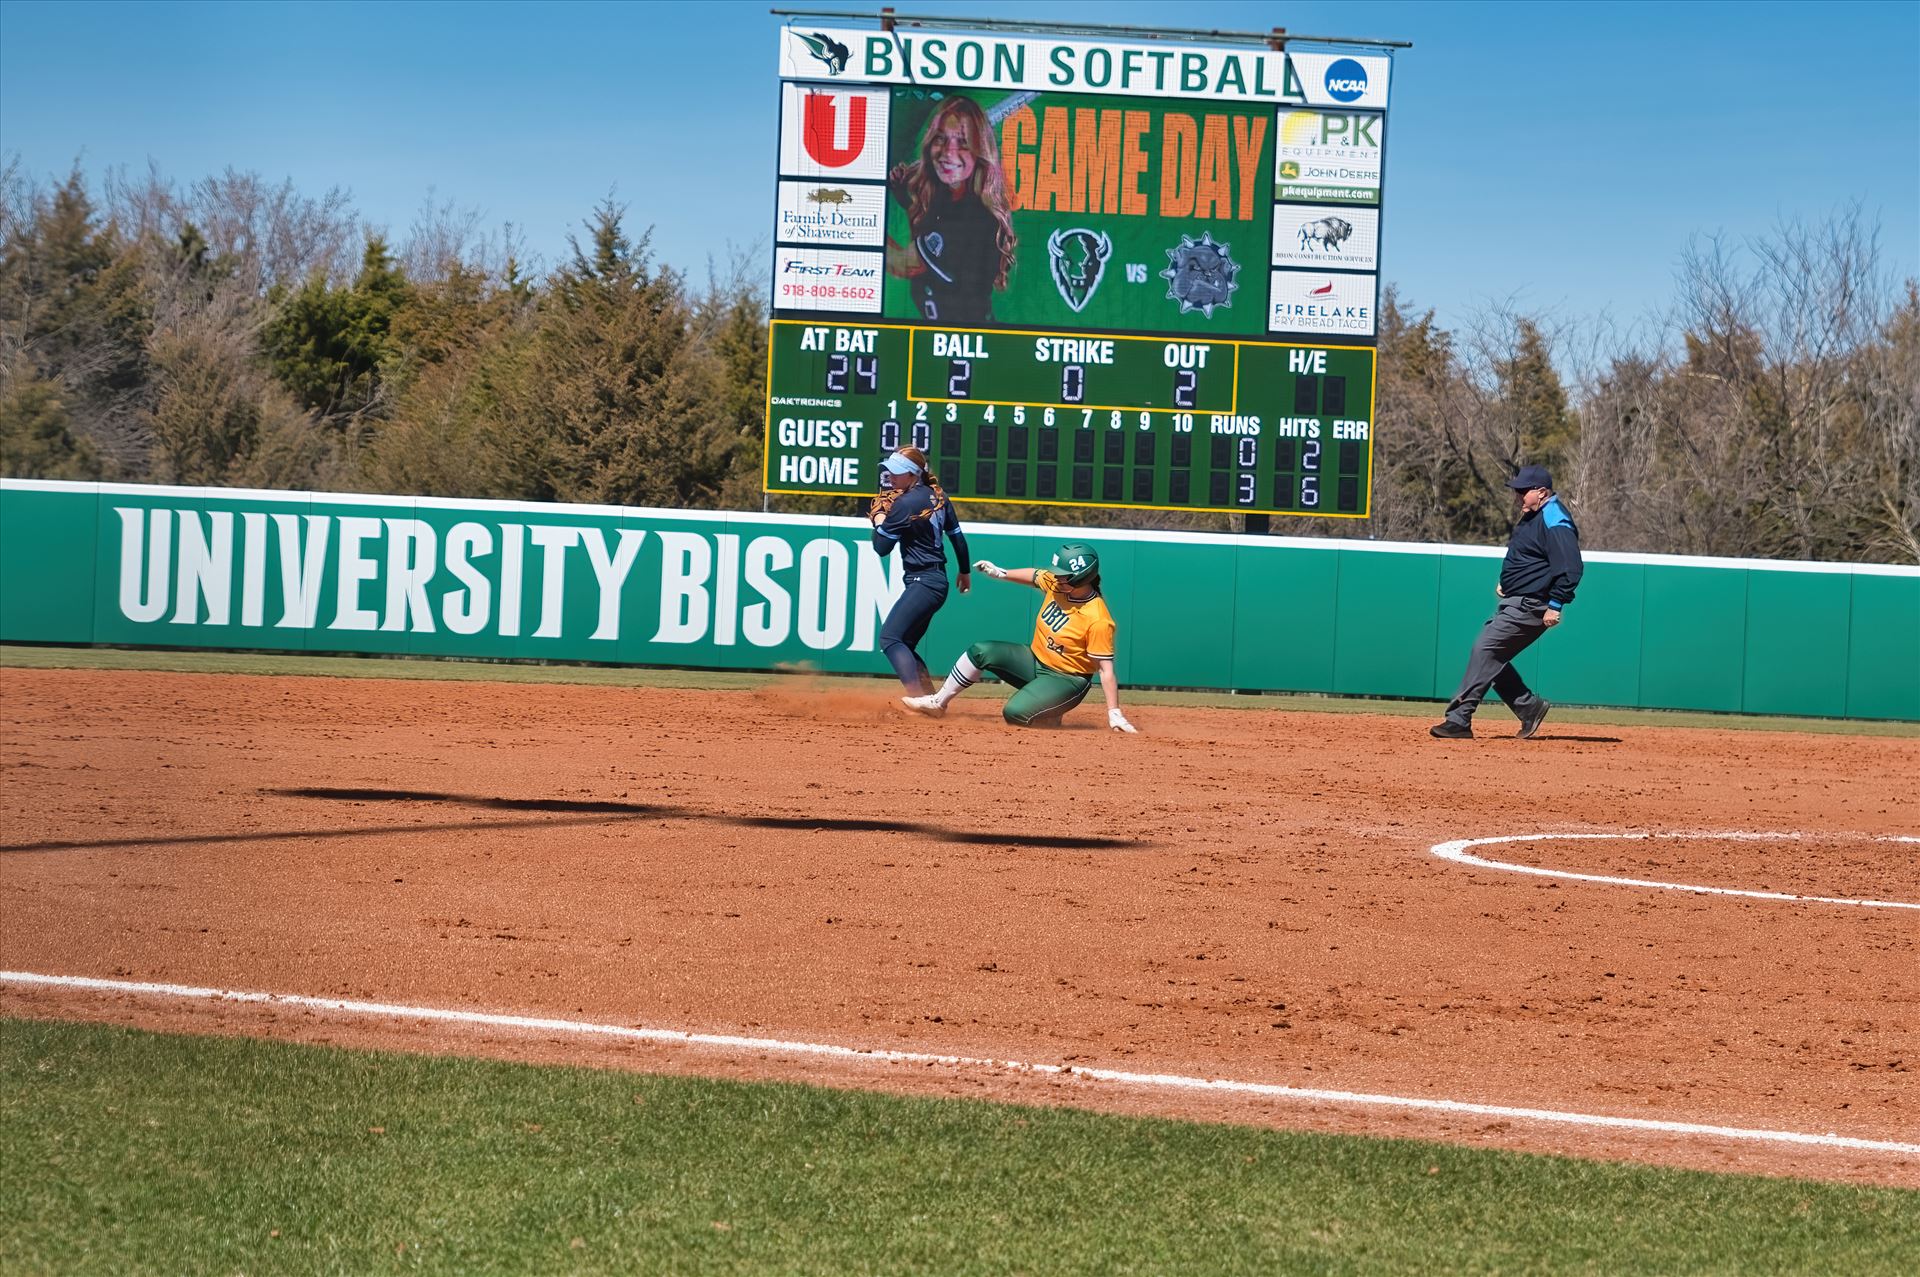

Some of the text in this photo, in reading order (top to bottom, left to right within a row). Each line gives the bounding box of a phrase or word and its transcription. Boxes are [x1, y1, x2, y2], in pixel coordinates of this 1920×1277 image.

[865, 36, 1303, 98] BISON SOFTBALL
[1328, 78, 1368, 94] NCAA
[1001, 104, 1268, 221] GAME DAY
[1281, 148, 1379, 160] EQUIPMENT
[1304, 167, 1379, 180] JOHN DEERE
[1281, 186, 1374, 200] pkequipment.com
[783, 210, 877, 228] Family Dental
[784, 225, 855, 240] of Shawnee
[833, 263, 876, 278] TEAM
[1125, 263, 1148, 284] VS
[782, 284, 876, 300] 918-808-6602
[1274, 316, 1368, 330] FRY BREAD TACO
[1275, 303, 1369, 319] FIRELAKE
[800, 327, 879, 354] AT BAT
[933, 333, 989, 359] BALL
[1035, 337, 1114, 365] STRIKE
[1164, 343, 1211, 369] OUT
[1288, 349, 1328, 376] H/E
[827, 354, 878, 391] 24
[949, 360, 970, 397] 2
[1062, 365, 1084, 401] 0
[1175, 370, 1196, 407] 2
[887, 400, 1369, 440] 1 2 3 4 5 6 7 8 9 10 RUNS HITS ERR
[778, 418, 1320, 470] GUEST 0 0 0 2
[779, 455, 859, 486] HOME
[1238, 473, 1254, 504] 3
[1301, 476, 1318, 506] 6
[1068, 555, 1087, 571] 24
[114, 507, 905, 653] UNIVERSITY BISON
[1041, 600, 1070, 633] OBU
